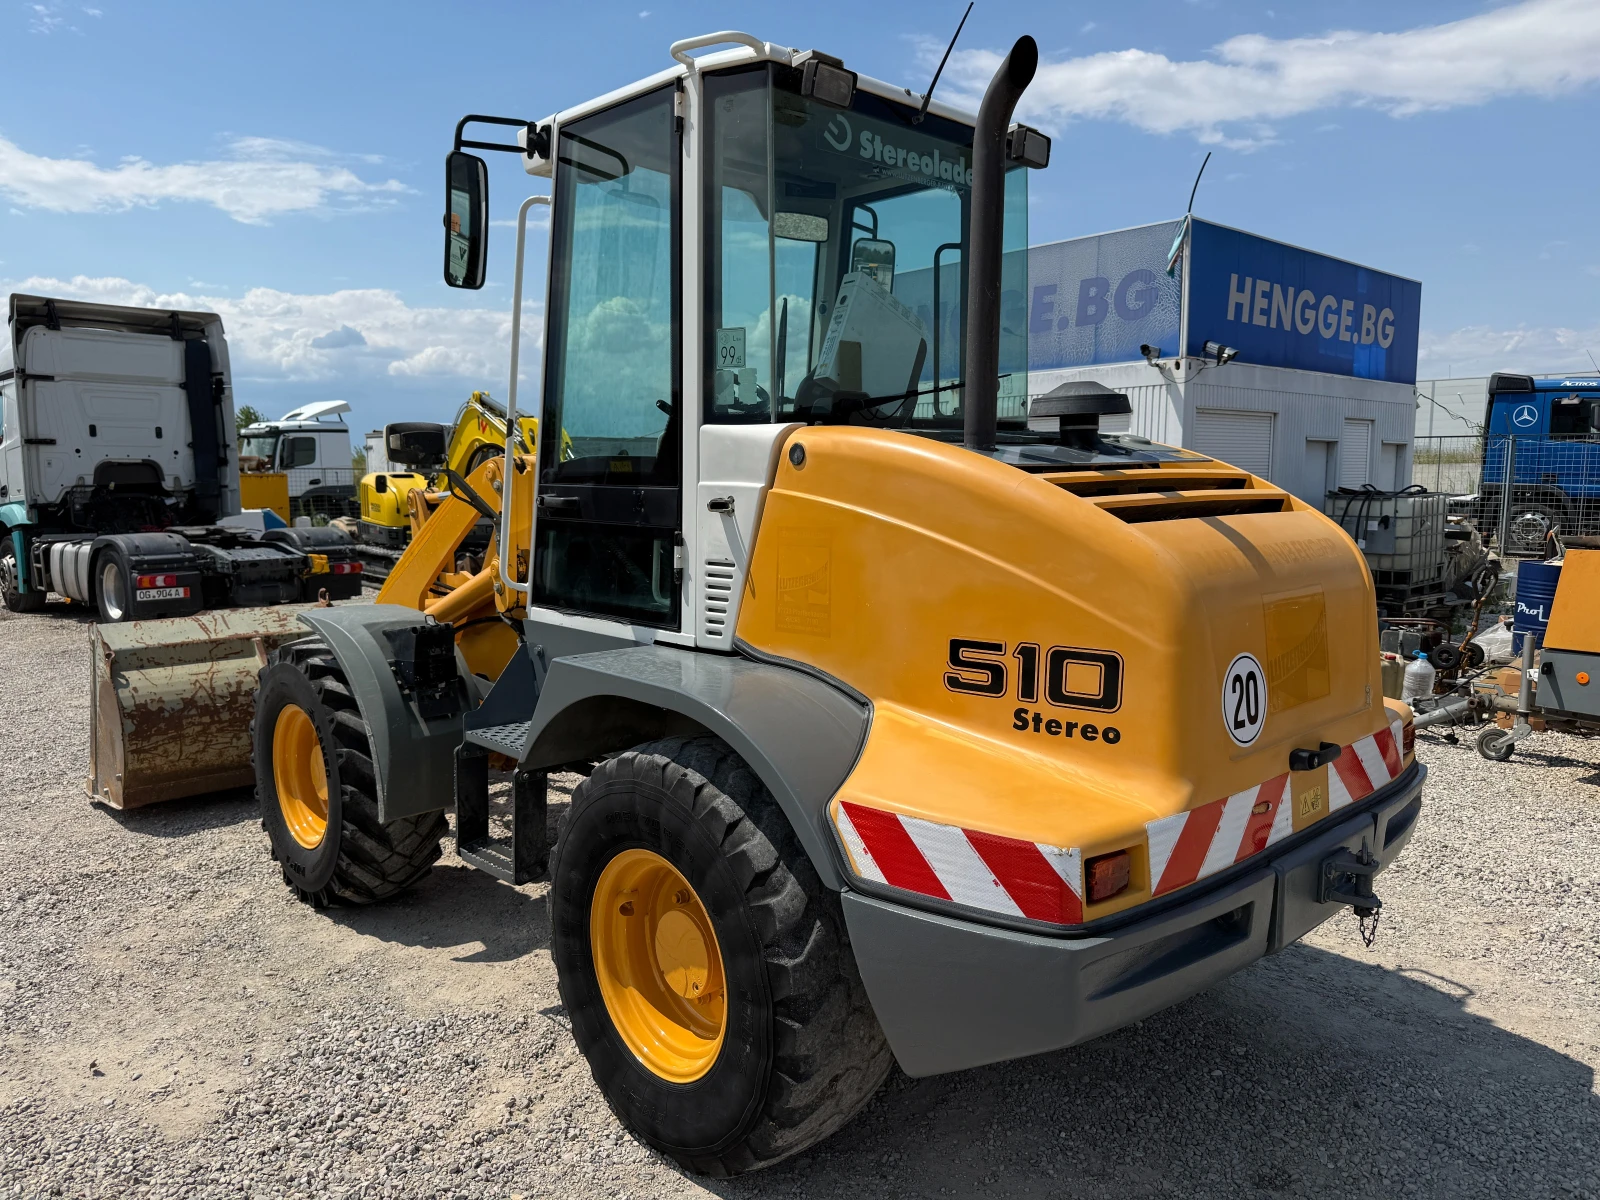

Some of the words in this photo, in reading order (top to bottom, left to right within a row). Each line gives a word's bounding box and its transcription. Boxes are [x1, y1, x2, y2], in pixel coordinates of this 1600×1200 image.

[859, 130, 973, 187] Stereolade
[1227, 273, 1395, 349] HENGGE.BG
[721, 346, 736, 364] 99
[943, 637, 1125, 714] 510
[1232, 671, 1260, 730] 20
[1012, 707, 1121, 745] Stereo
